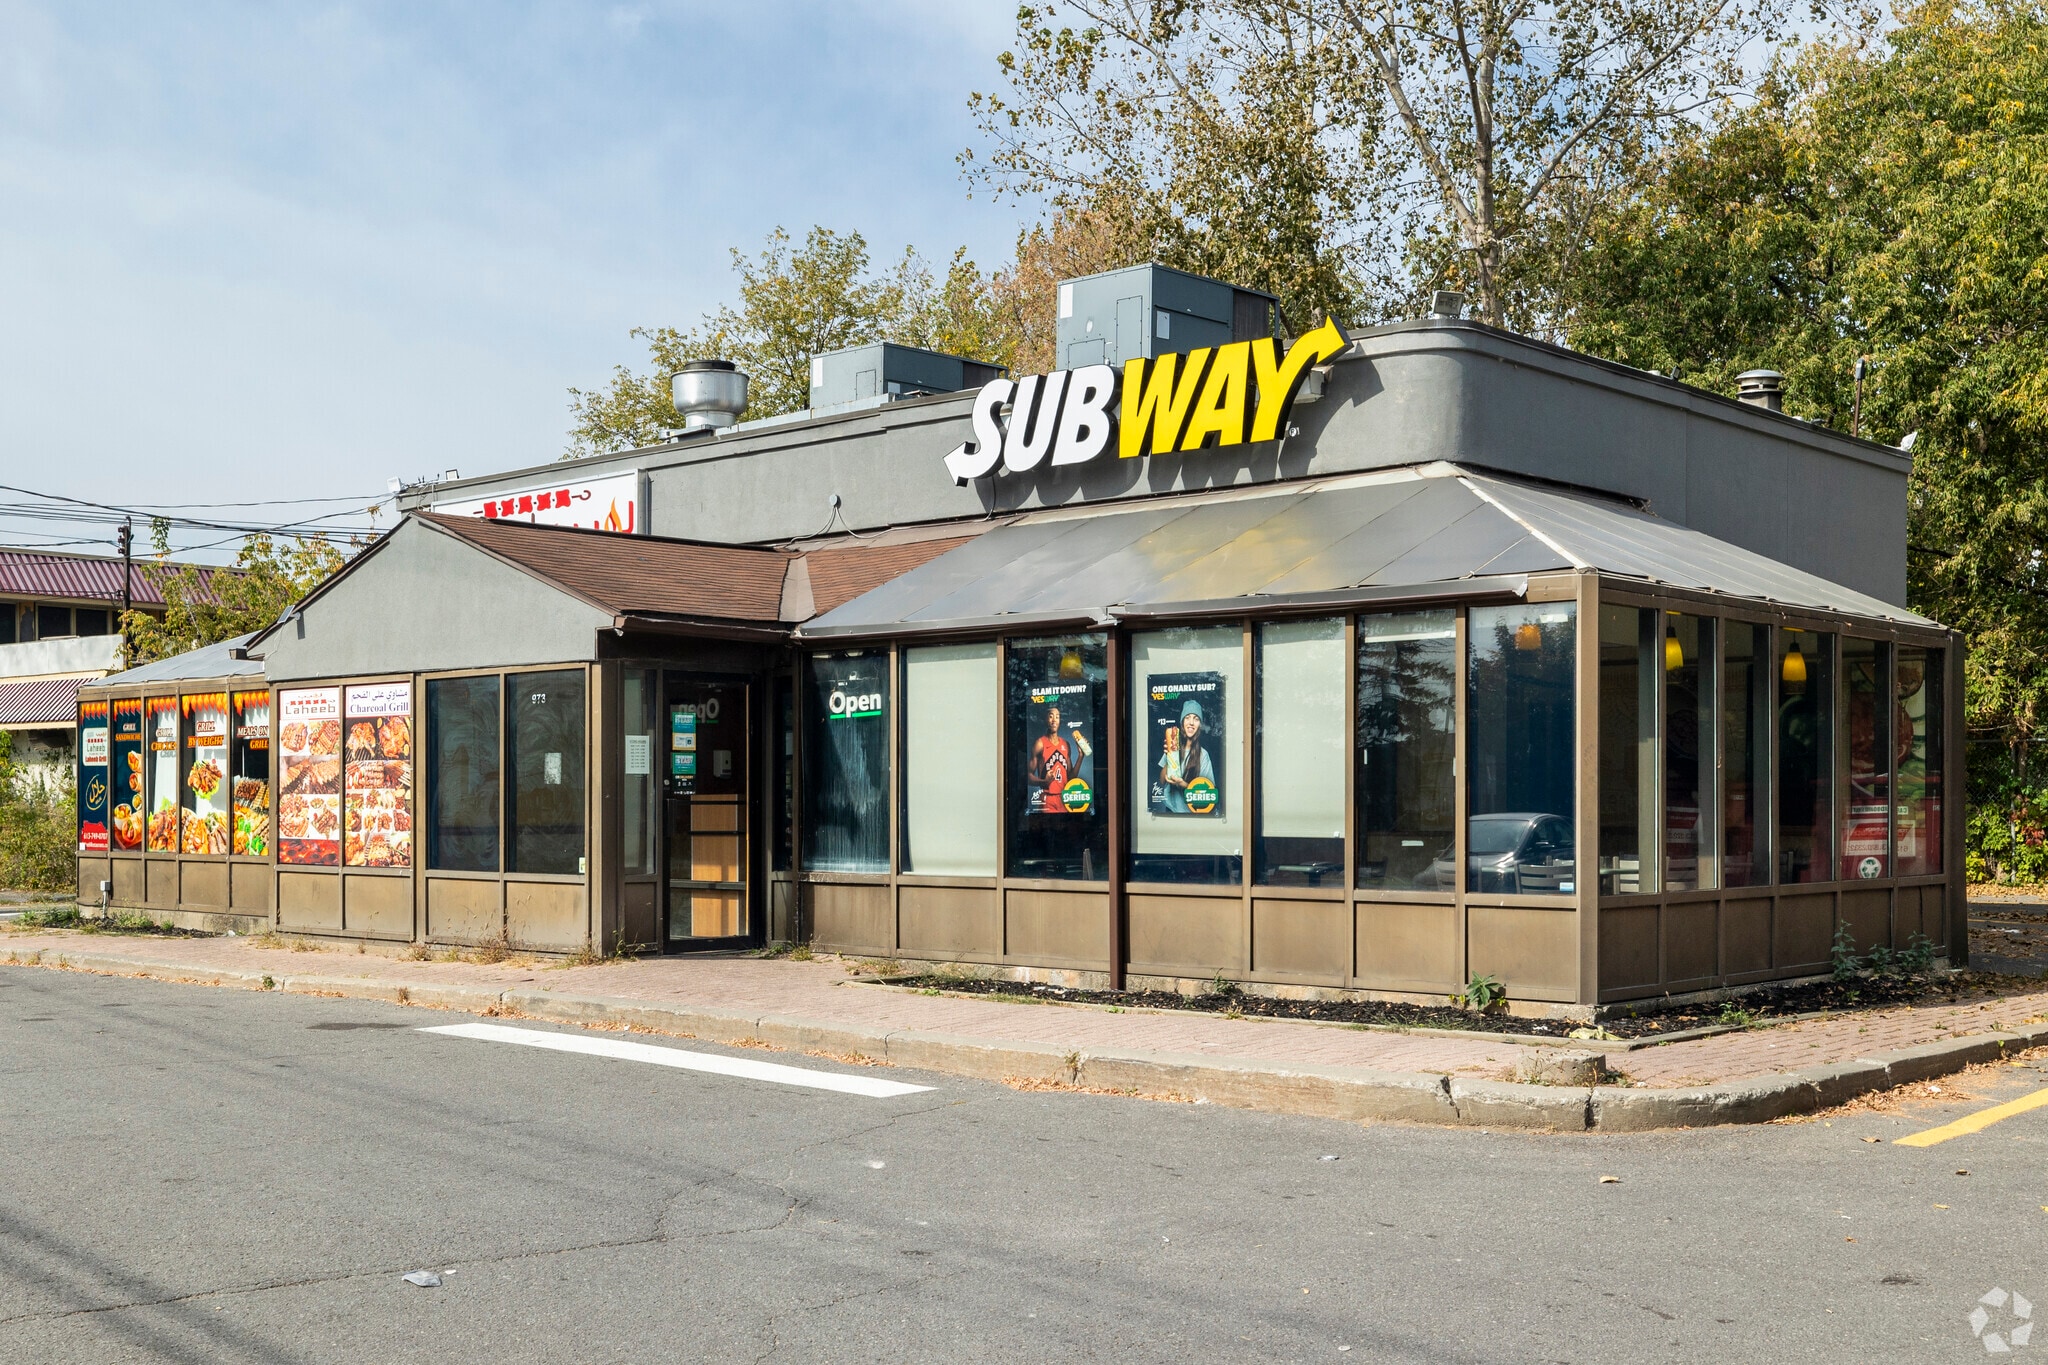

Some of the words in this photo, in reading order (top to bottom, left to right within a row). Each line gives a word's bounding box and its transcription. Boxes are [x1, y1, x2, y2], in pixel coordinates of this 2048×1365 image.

[943, 316, 1350, 487] SUBWAY
[1031, 687, 1052, 696] SLAM
[1053, 686, 1060, 695] IT
[1060, 684, 1087, 694] DOWN?
[1152, 685, 1168, 693] ONE
[1167, 683, 1197, 692] GNARLY
[1196, 683, 1217, 691] SUB?
[531, 694, 546, 704] 973
[829, 691, 882, 718] Open
[285, 703, 336, 715] Laheeb
[350, 703, 387, 714] Charcoal
[388, 702, 409, 712] Grill
[196, 721, 215, 732] GRILL
[237, 726, 258, 737] MEALS
[258, 725, 269, 736] ON
[196, 735, 224, 747] WEIGHT
[249, 739, 269, 750] GRILL
[1062, 793, 1091, 803] SERIES
[1186, 792, 1217, 803] SERIES
